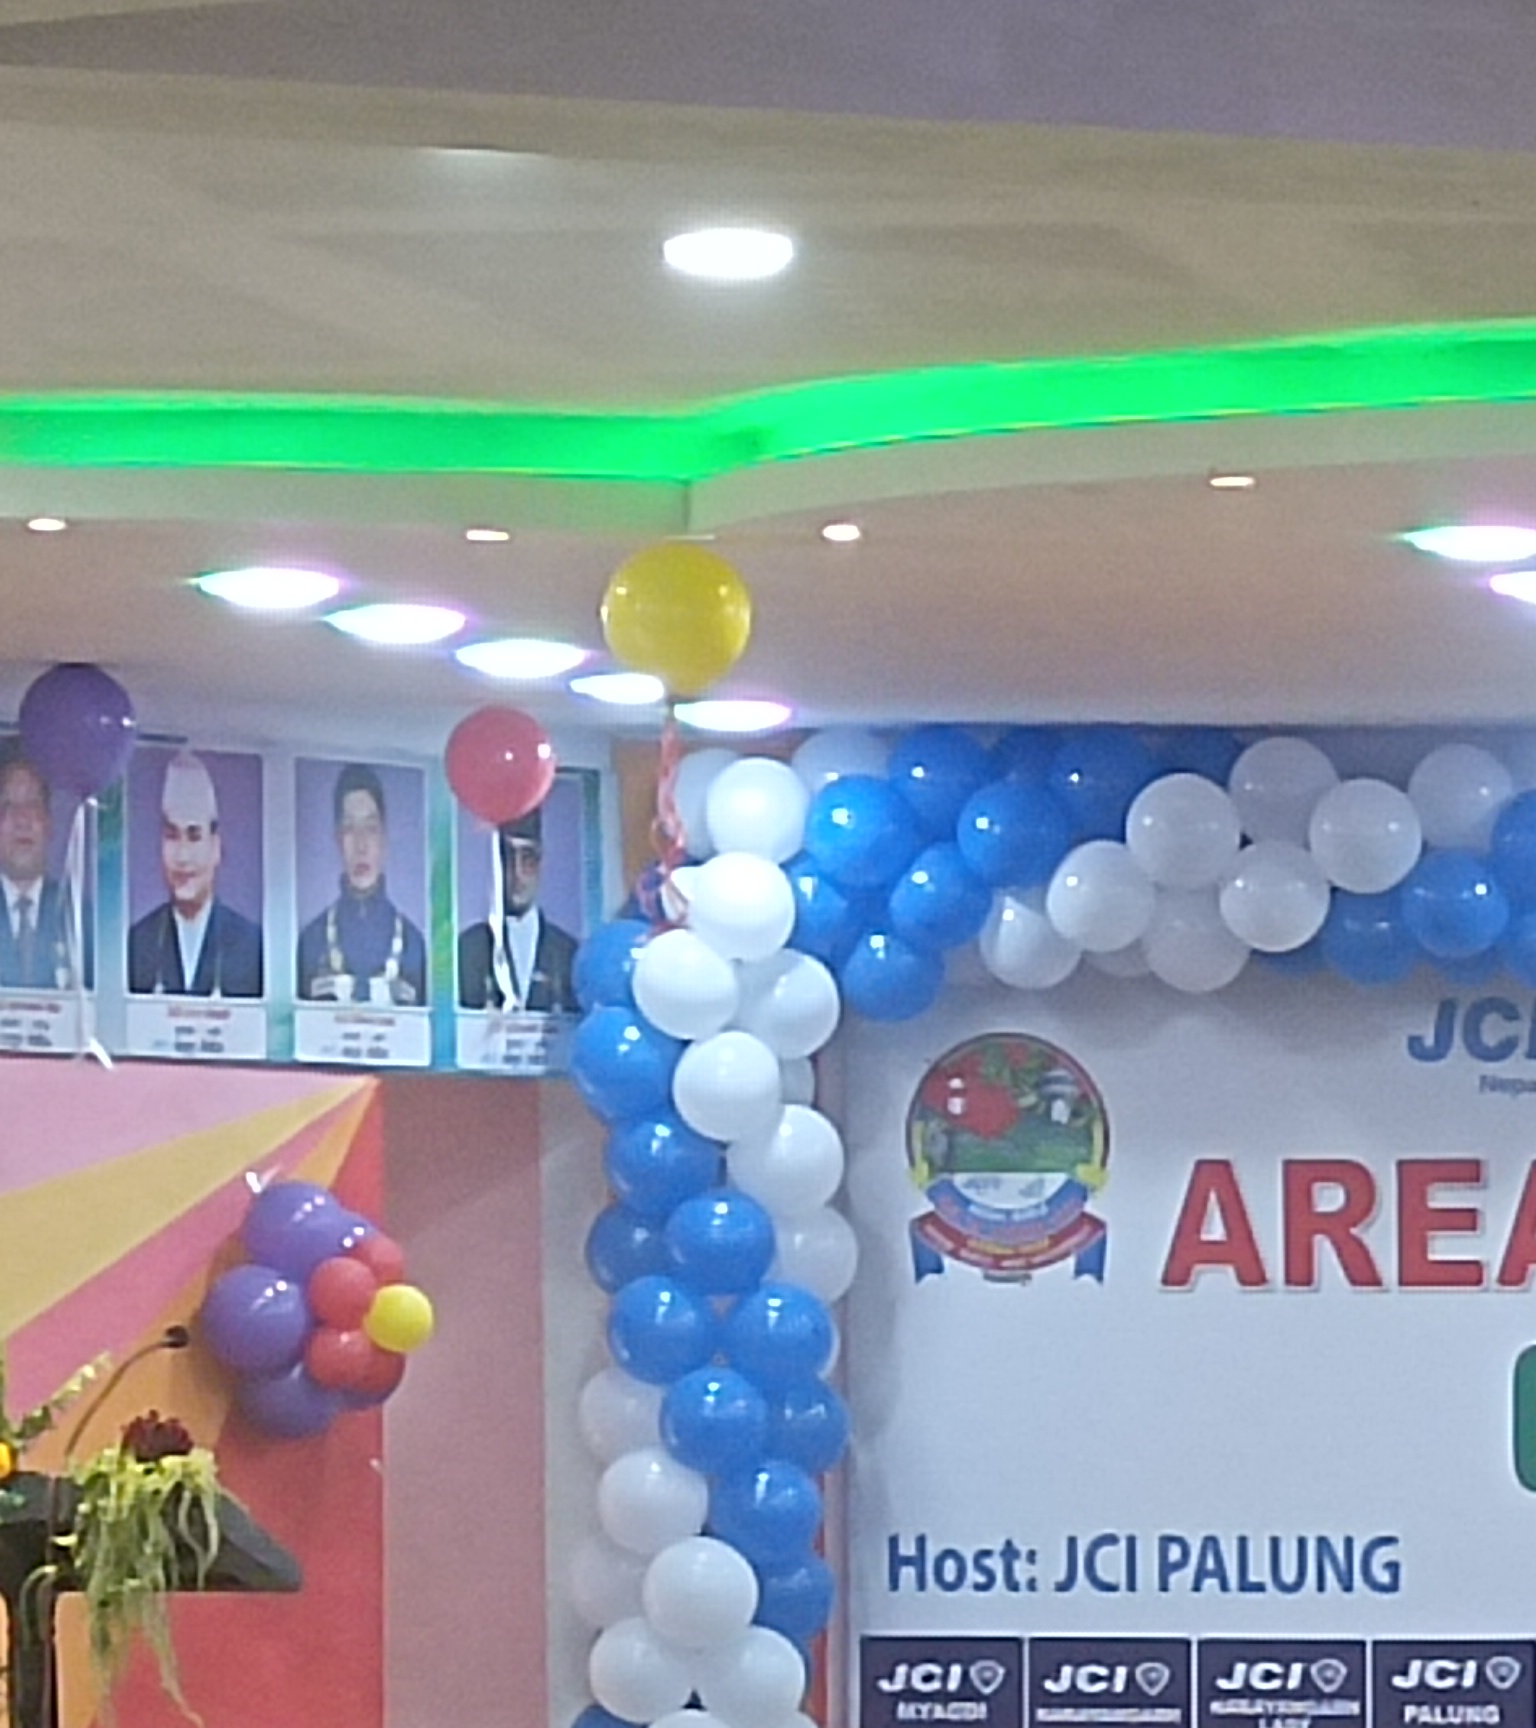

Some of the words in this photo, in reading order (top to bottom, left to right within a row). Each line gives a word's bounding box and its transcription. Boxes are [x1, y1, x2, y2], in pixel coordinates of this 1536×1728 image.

[886, 1531, 1040, 1595] Host:
[1053, 1532, 1139, 1595] JCI
[1156, 1533, 1403, 1595] PALUNG
[878, 1662, 964, 1692] JCI
[1043, 1664, 1129, 1693] JCI
[1215, 1661, 1305, 1690] JCI
[1391, 1659, 1478, 1688] JCI
[1402, 1704, 1501, 1725] PALUNG
